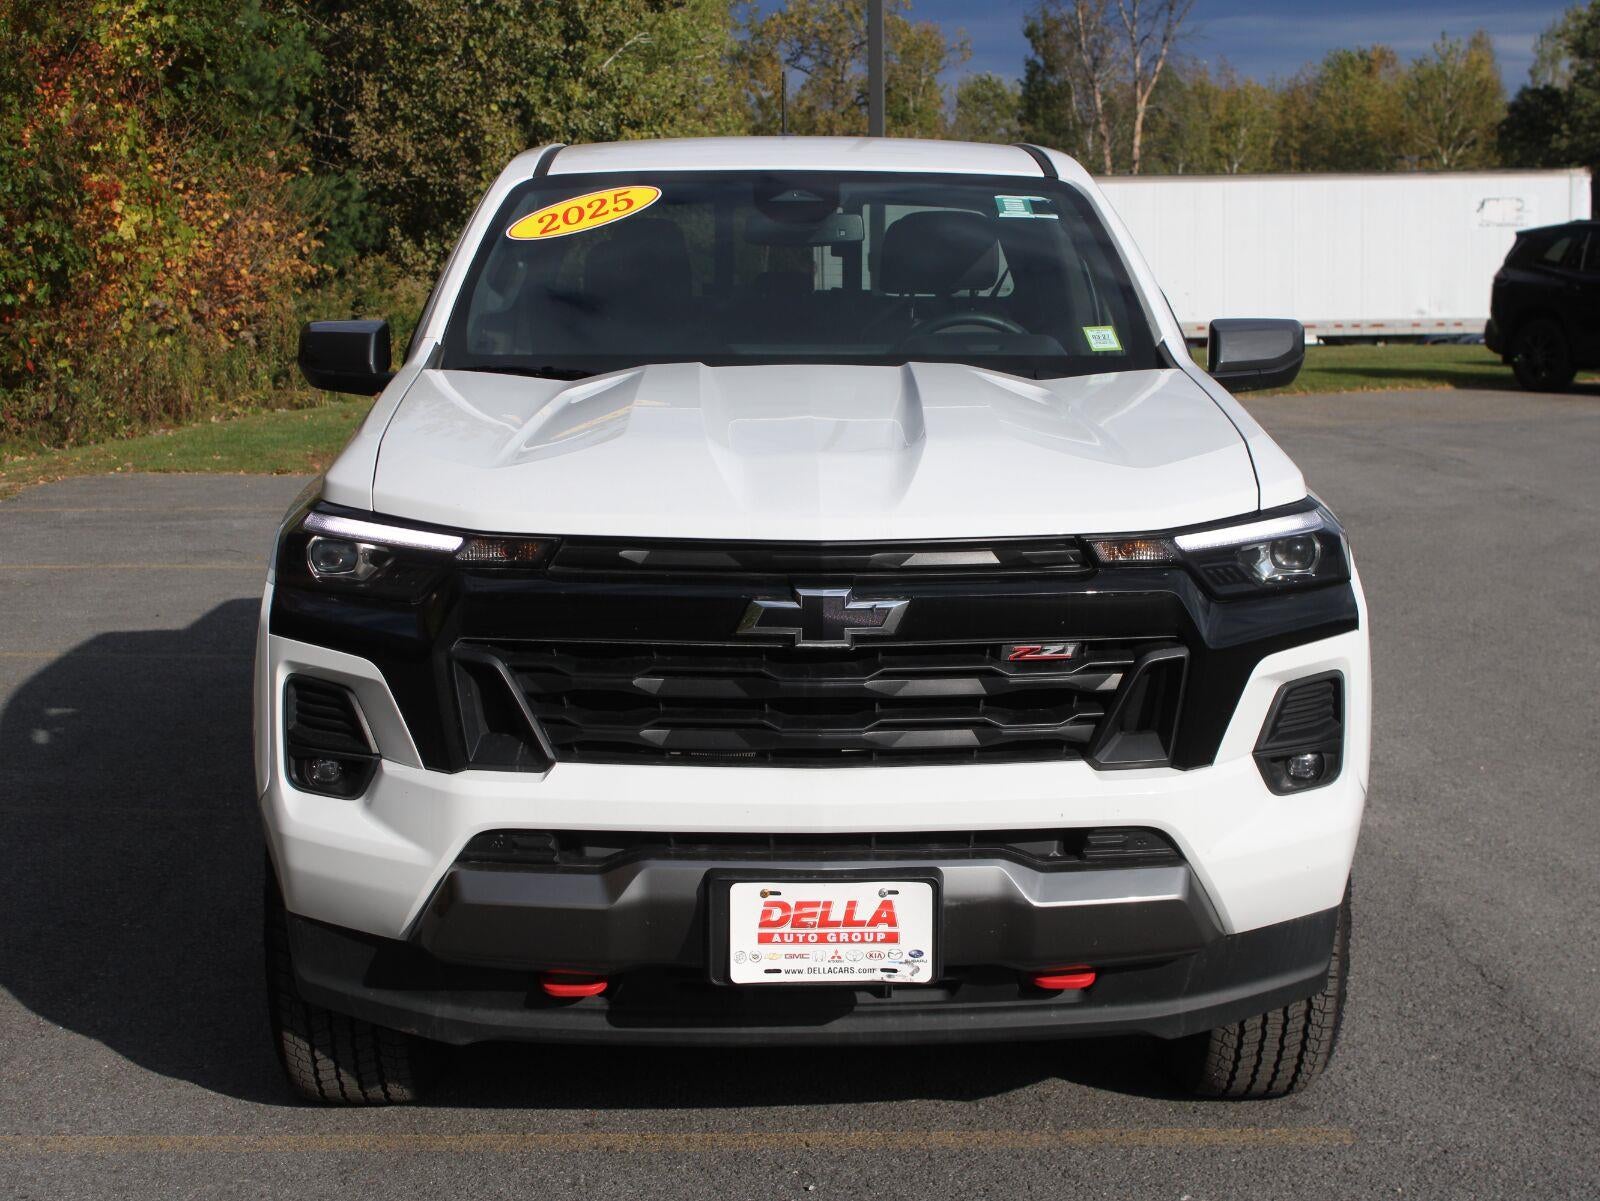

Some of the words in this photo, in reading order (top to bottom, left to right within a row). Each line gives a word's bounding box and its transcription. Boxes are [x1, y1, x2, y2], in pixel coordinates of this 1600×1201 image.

[538, 190, 635, 235] 2025
[1008, 645, 1077, 661] Z71
[758, 900, 899, 930] DELLA
[772, 933, 818, 943] AUTO
[827, 932, 886, 942] GROUP
